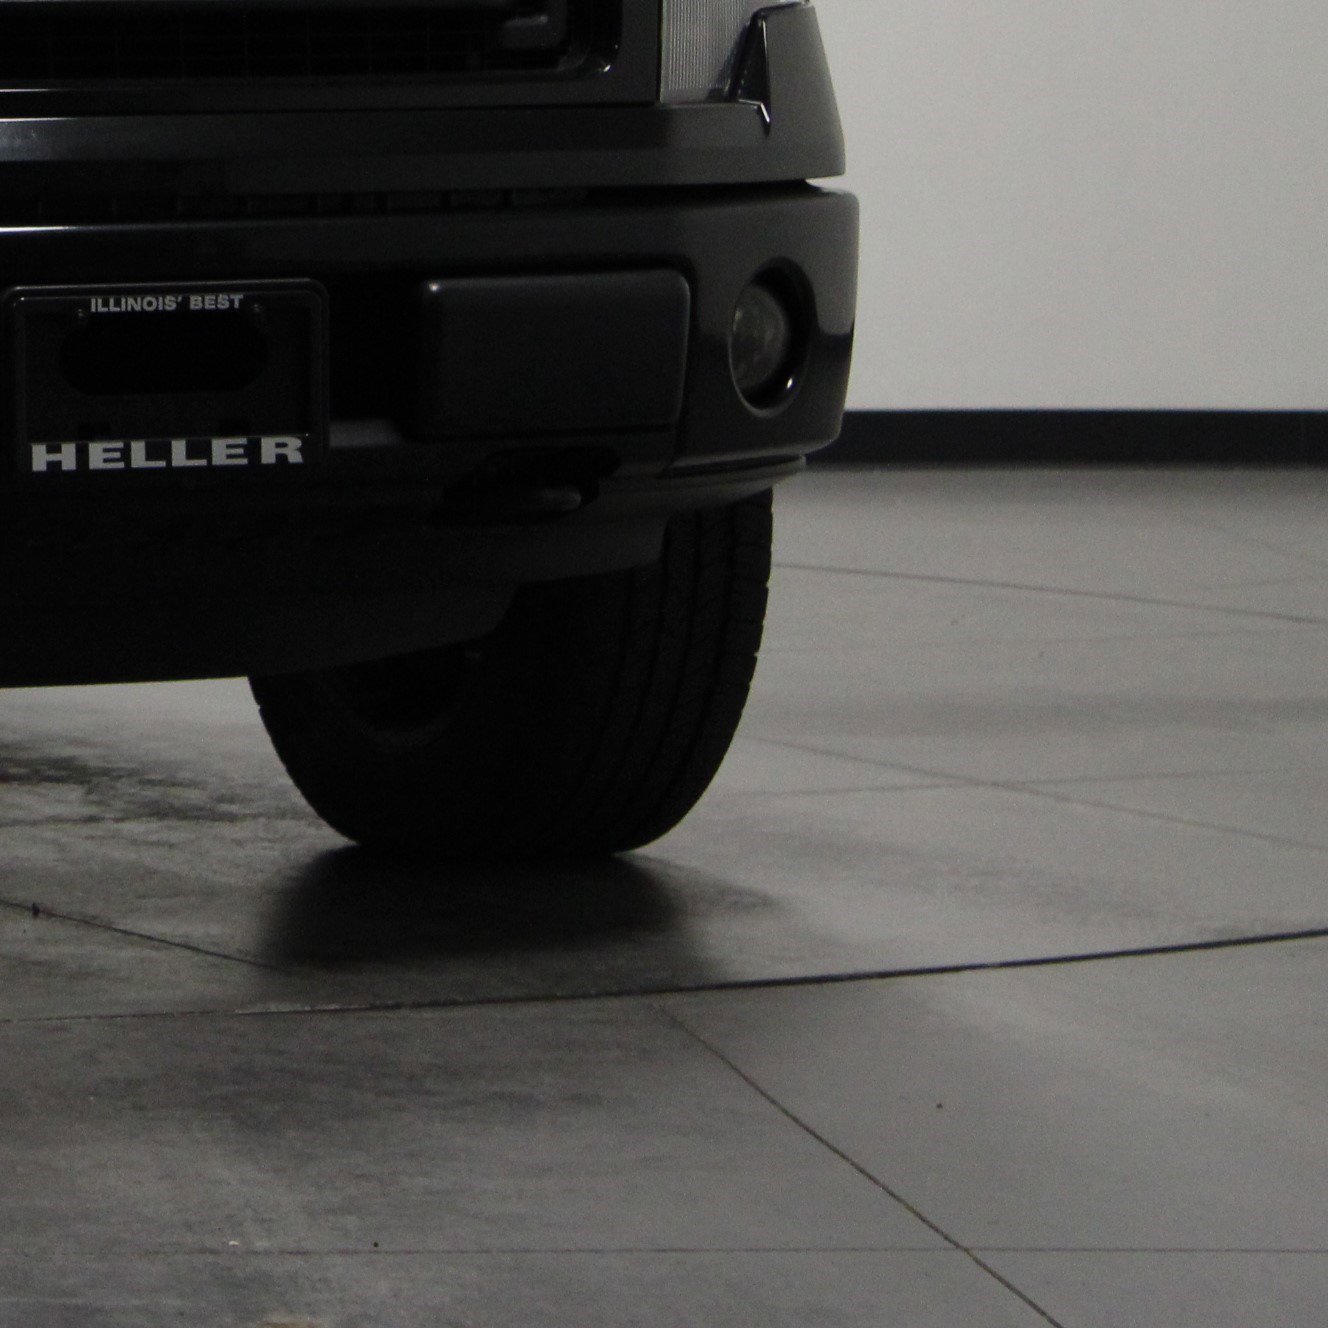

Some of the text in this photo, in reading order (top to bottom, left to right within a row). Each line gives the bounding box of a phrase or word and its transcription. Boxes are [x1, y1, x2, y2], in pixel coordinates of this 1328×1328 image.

[90, 292, 244, 313] ILLINOIS' BEST
[31, 436, 304, 472] HELLER
